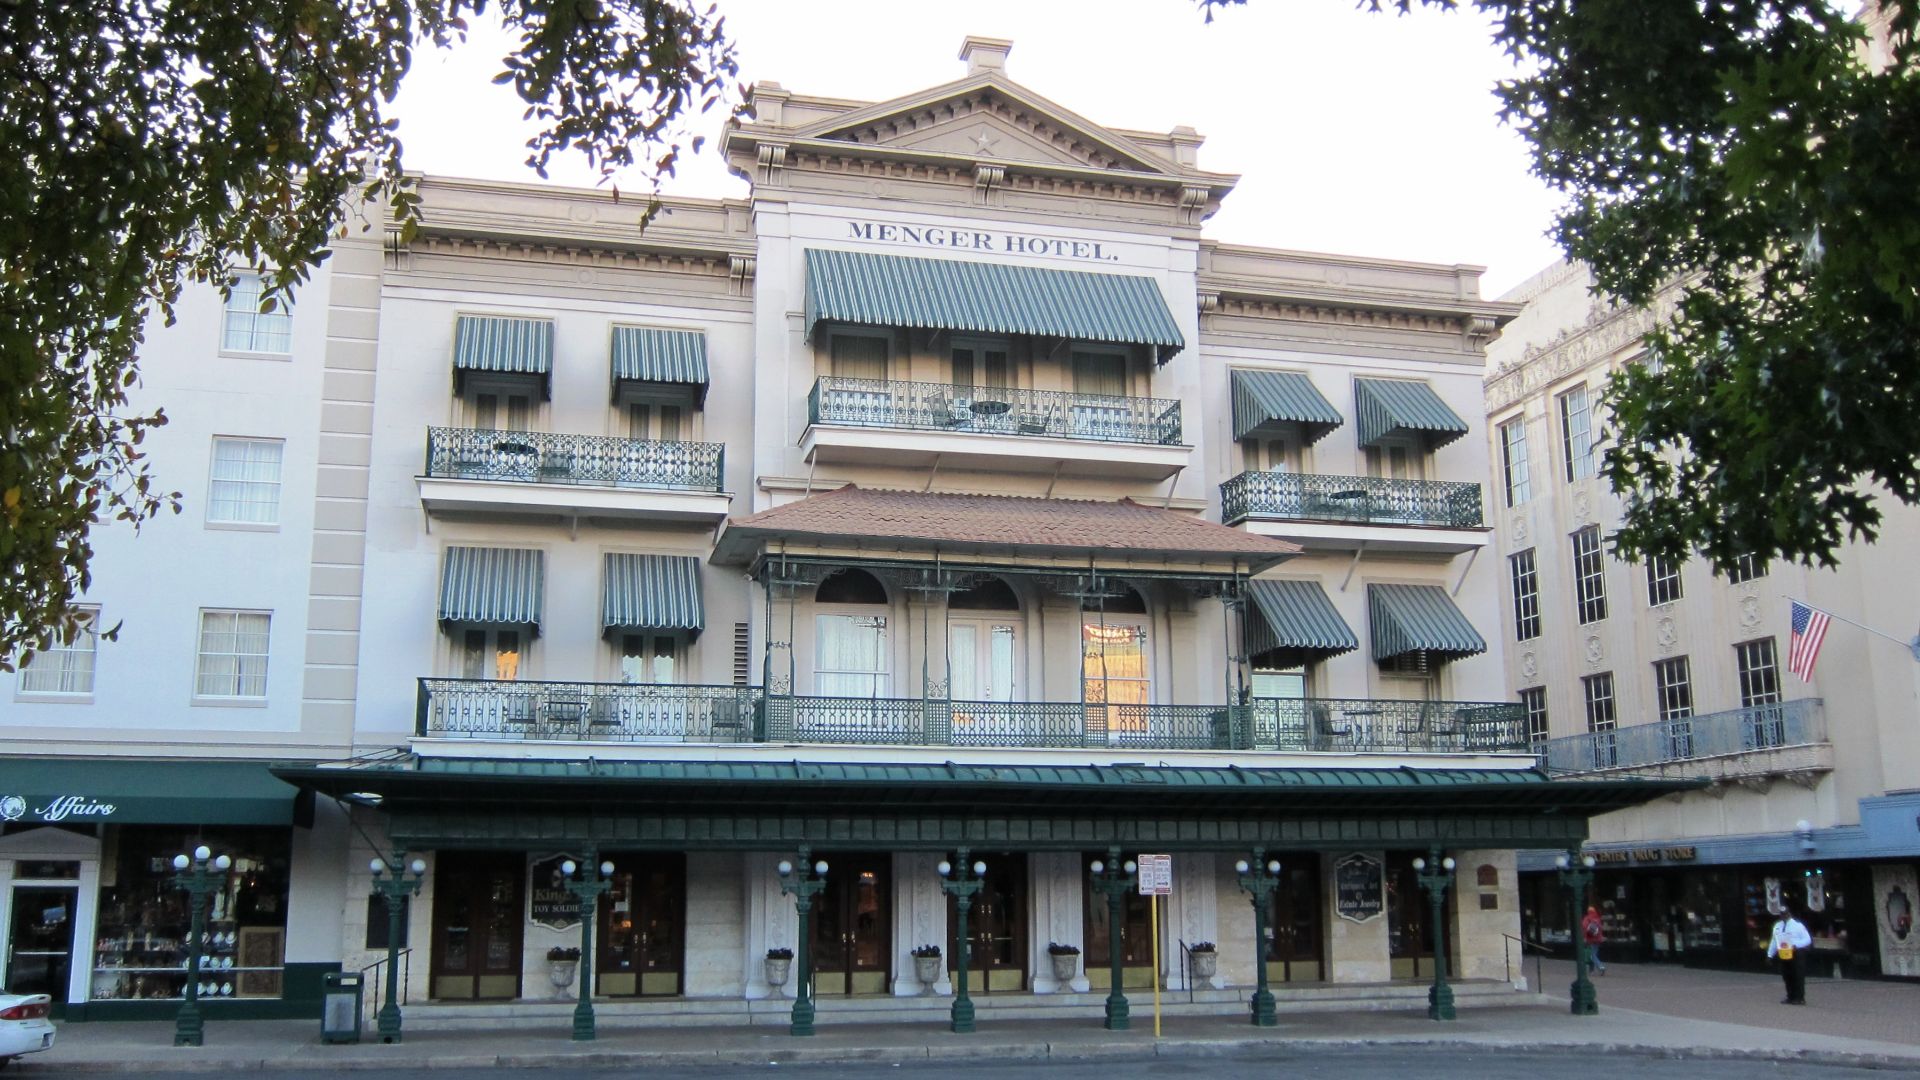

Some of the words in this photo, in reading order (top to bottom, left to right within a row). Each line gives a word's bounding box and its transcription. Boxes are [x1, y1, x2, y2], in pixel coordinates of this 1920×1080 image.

[847, 221, 994, 250] MENGER
[35, 795, 116, 821] Affairs
[1632, 847, 1658, 861] DRUG
[1663, 847, 1694, 860] STORE
[534, 904, 550, 912] TOY
[552, 904, 580, 912] SOLDIE
